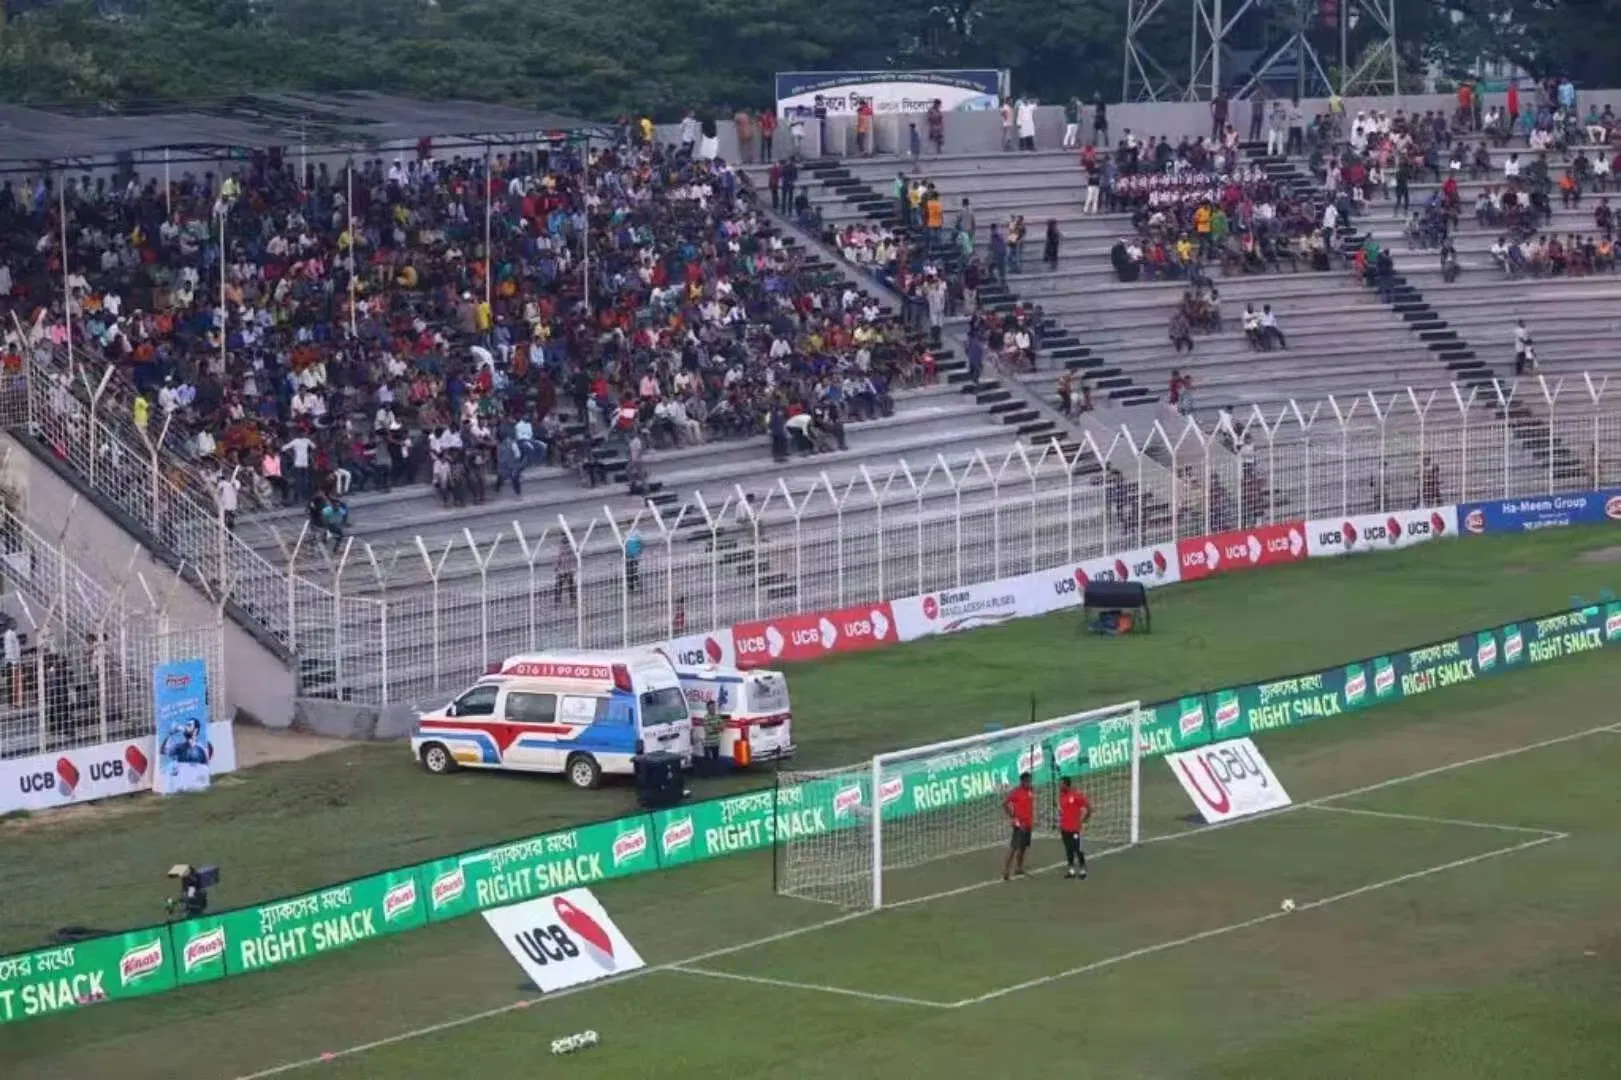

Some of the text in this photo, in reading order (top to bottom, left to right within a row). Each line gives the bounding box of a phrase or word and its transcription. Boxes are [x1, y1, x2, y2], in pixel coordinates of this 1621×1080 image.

[1502, 496, 1587, 514] Ha-Meem Group
[1320, 530, 1342, 544] UCB
[1364, 526, 1386, 540] UCB
[1408, 521, 1430, 535] UCB
[1225, 544, 1248, 558] UCB
[1267, 537, 1289, 551] UCB
[1133, 560, 1154, 576] UCB
[1182, 551, 1205, 565] UCB
[1054, 578, 1076, 595] UCB
[940, 591, 970, 606] Biman
[791, 628, 819, 645] UCB
[844, 620, 871, 636] UCB
[736, 638, 766, 654] UCB
[1528, 627, 1604, 663] RIGHT SNACK
[1402, 659, 1475, 696] RIGHT SNACK
[1248, 692, 1341, 731] RIGHT SNACK
[1088, 727, 1175, 769] RIGHT NACK
[90, 758, 124, 781] UCB
[1178, 744, 1268, 813] Upay
[20, 771, 56, 793] UCB
[913, 767, 1010, 811] RIGHT SNACK
[705, 807, 826, 854] RIGHT SNACK
[476, 852, 604, 906] RIGHT SNACK
[240, 907, 376, 969] RIGHT SNACK
[514, 924, 580, 966] UCB
[21, 970, 105, 1015] SNACK
